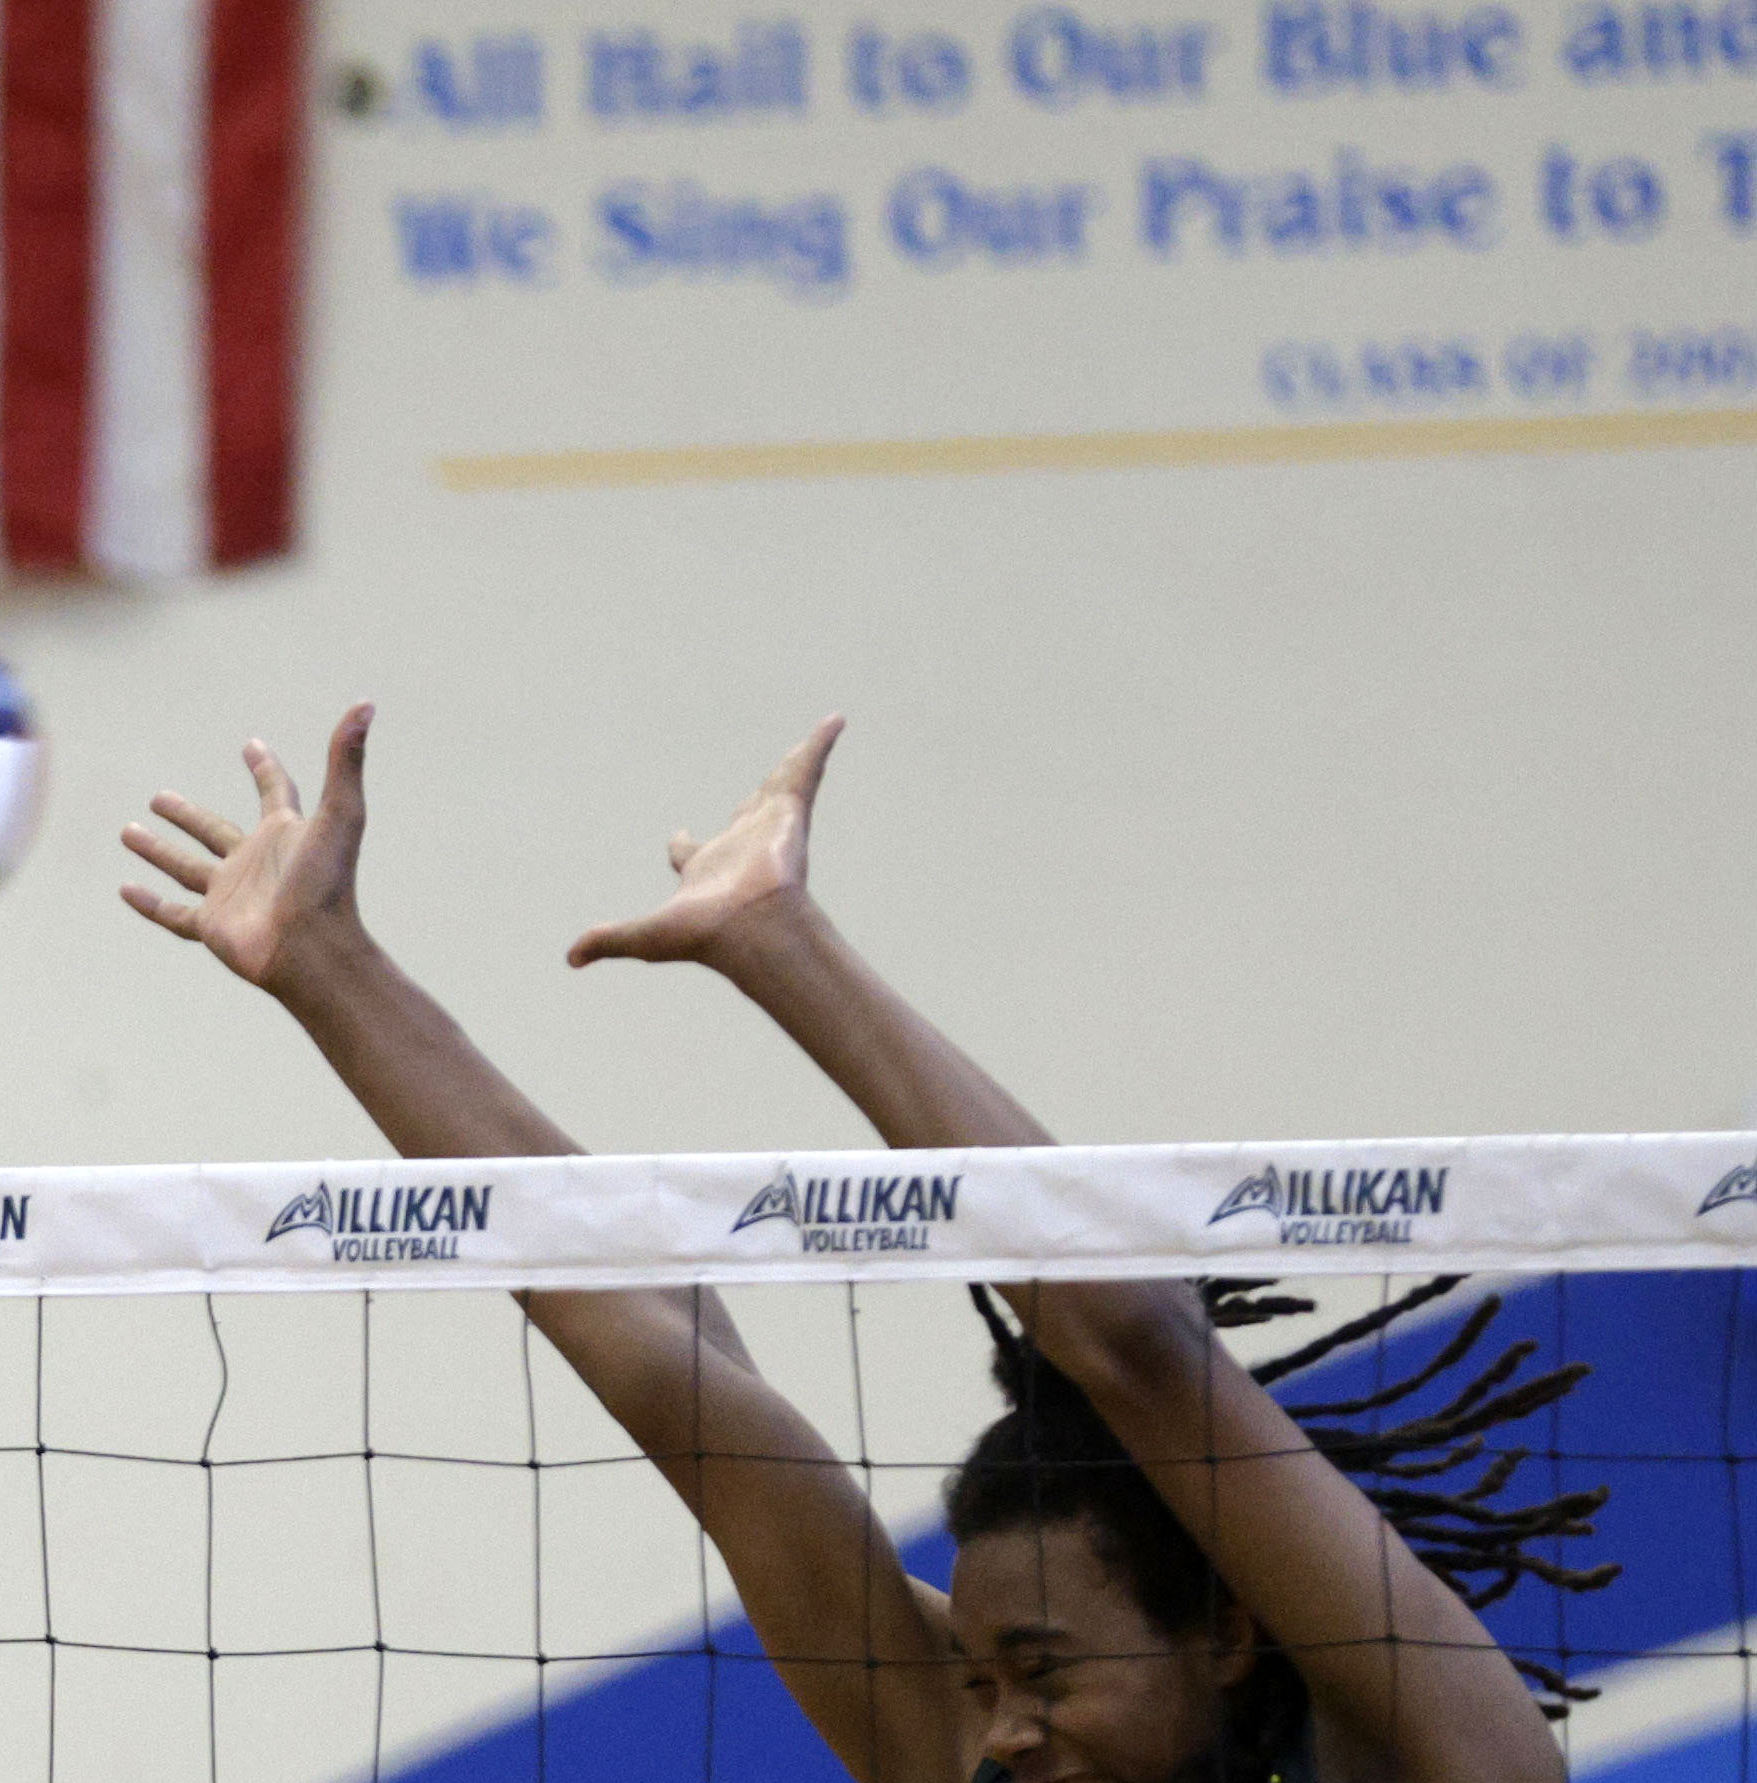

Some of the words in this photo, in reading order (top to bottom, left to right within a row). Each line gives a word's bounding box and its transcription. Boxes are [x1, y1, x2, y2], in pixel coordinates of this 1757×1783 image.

[585, 22, 808, 122] Hail
[848, 18, 972, 115] to
[1007, 5, 1213, 108] Our
[1263, 0, 1524, 95] Blue
[394, 188, 554, 284] We
[591, 175, 852, 300] Sing
[886, 165, 1098, 268] Our
[1138, 144, 1504, 260] Praise
[1540, 138, 1668, 246] to
[802, 1227, 929, 1252] VOLLEYBALL
[1281, 1220, 1412, 1244] VOLLEYBALL
[333, 1237, 459, 1262] VOLLEYBALL
